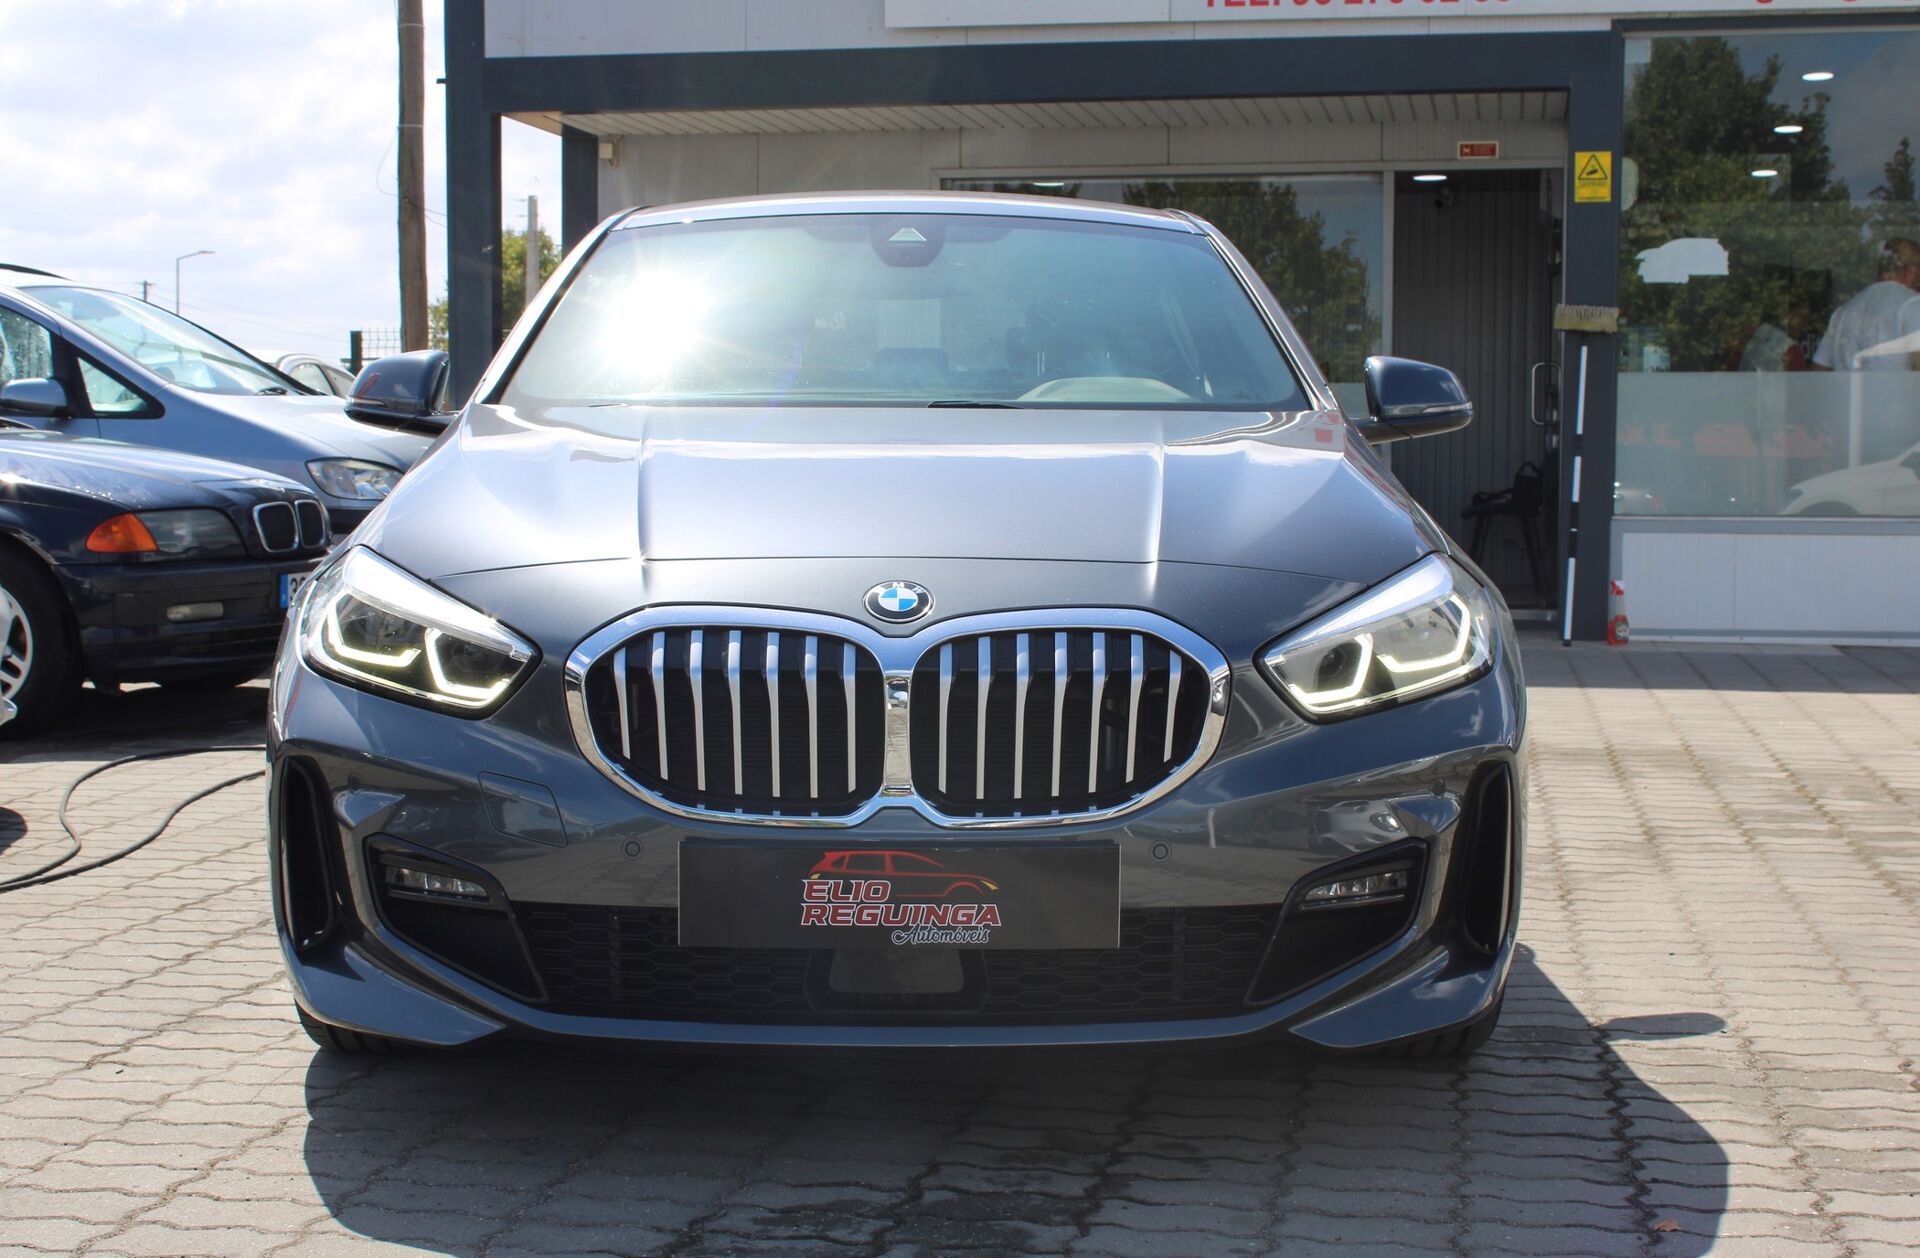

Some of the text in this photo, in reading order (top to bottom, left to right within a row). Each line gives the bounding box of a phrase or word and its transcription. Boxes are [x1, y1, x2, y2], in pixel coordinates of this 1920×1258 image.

[802, 879, 891, 903] ELIO
[801, 903, 1002, 927] REGUINGA
[891, 922, 992, 945] Automóveis
